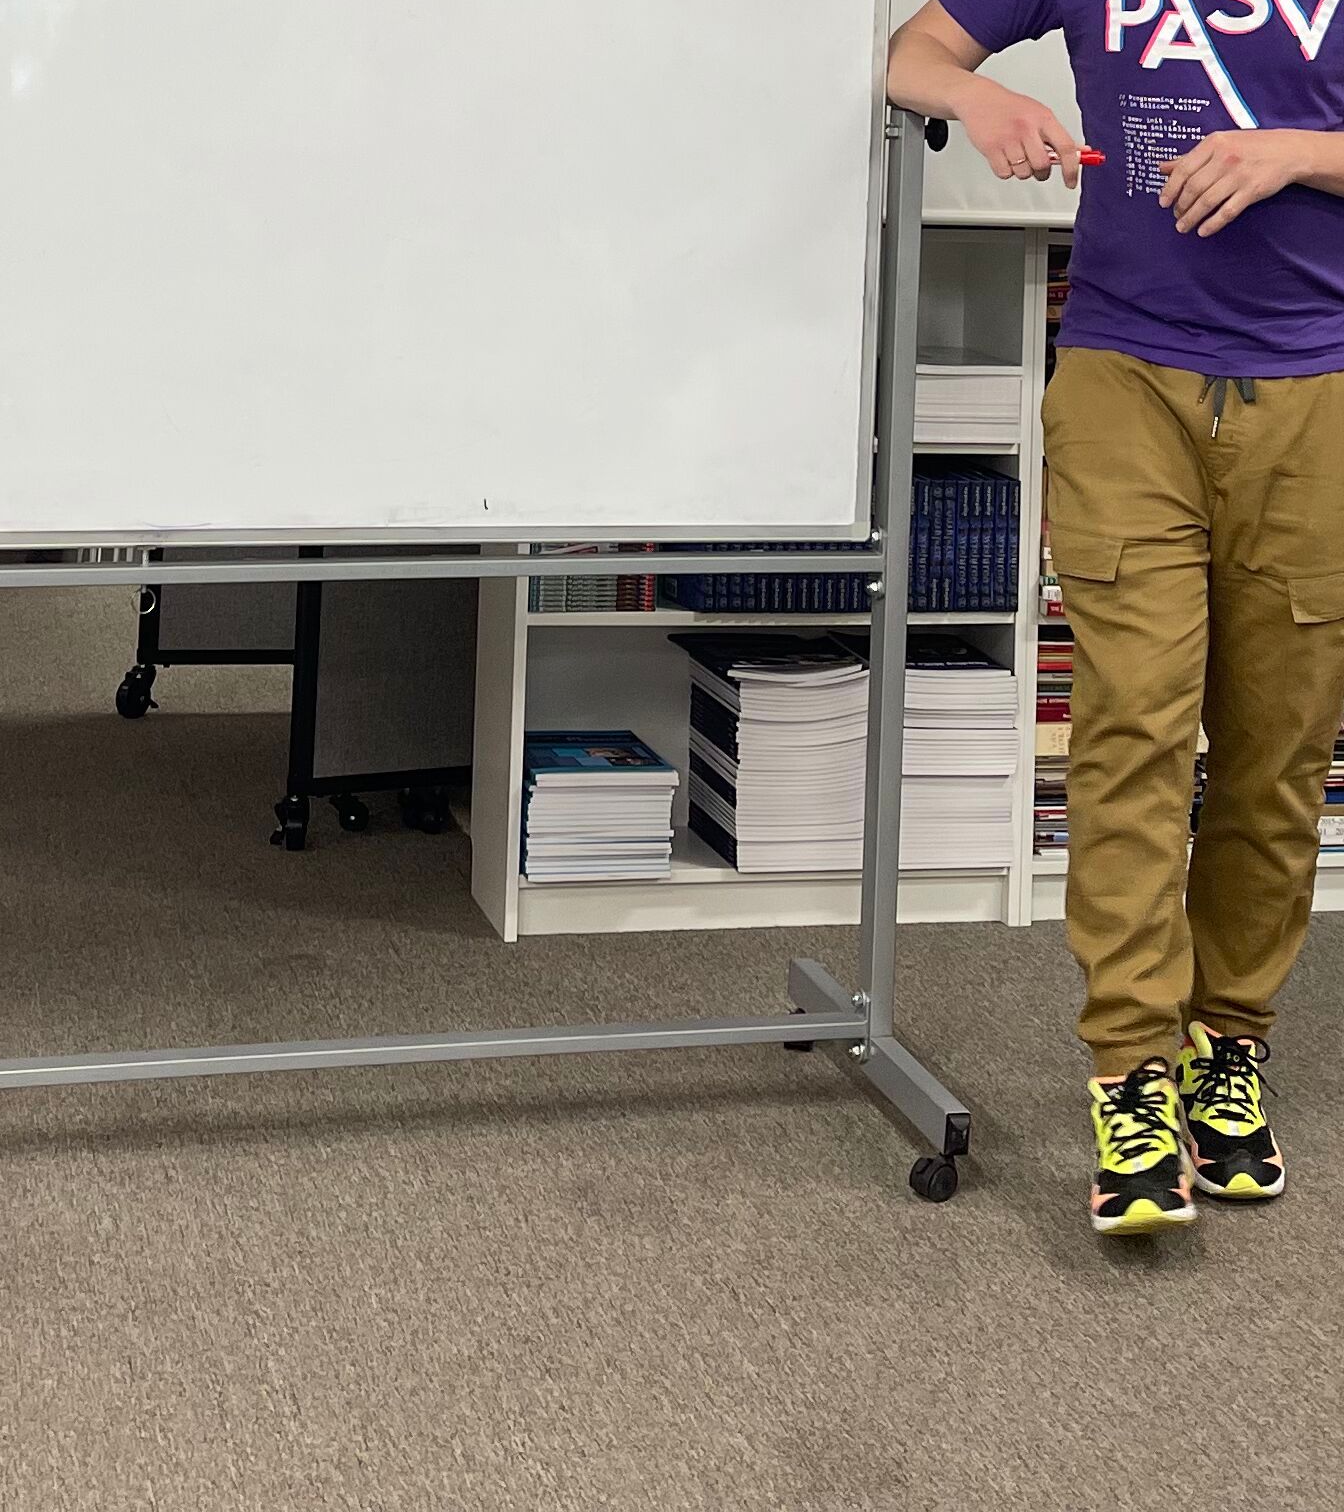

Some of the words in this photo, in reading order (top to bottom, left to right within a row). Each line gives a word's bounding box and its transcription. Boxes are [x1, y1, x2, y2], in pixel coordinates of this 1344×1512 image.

[1128, 94, 1175, 105] Programming
[1178, 97, 1211, 107] Academy
[1139, 101, 1171, 110] Silicon
[1173, 103, 1202, 113] Valley
